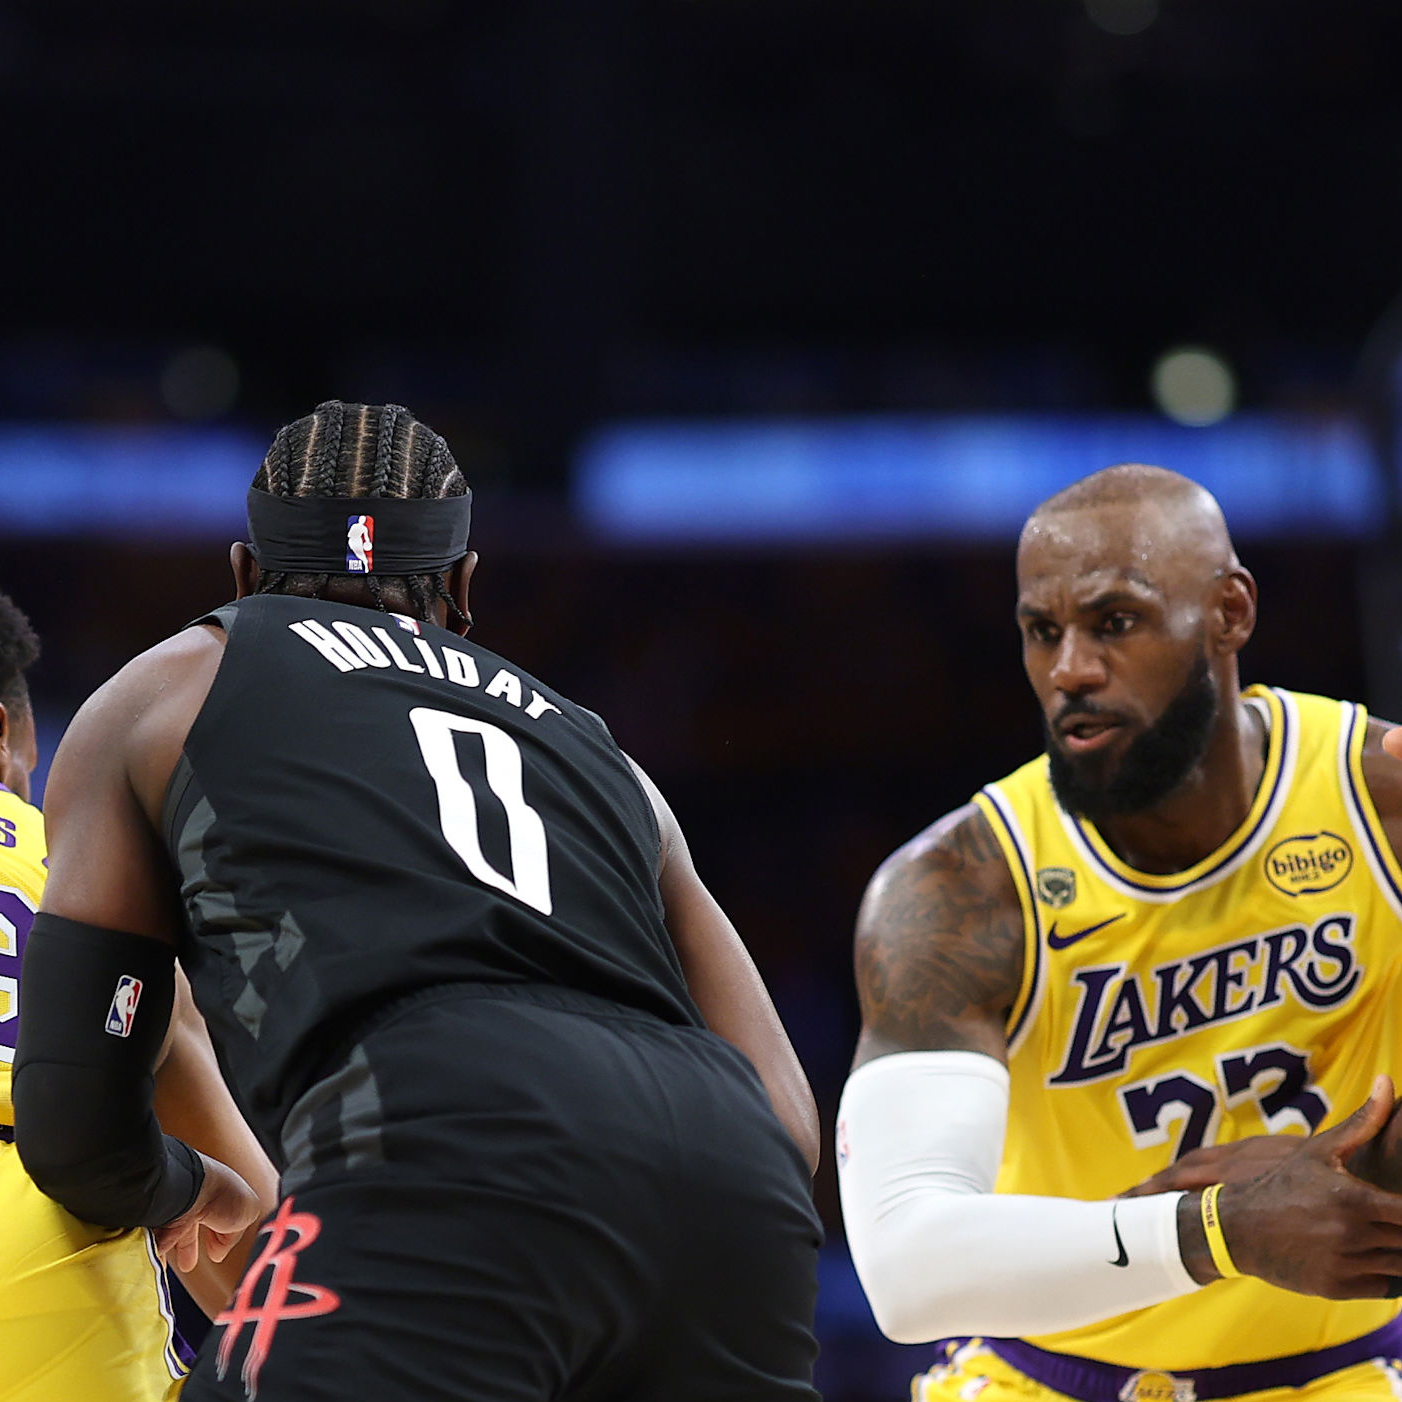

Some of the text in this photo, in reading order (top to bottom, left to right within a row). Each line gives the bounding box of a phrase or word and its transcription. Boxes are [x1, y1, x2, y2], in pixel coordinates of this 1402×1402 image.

[287, 618, 563, 721] HOLIDAY
[408, 706, 553, 917] 0
[1271, 848, 1347, 876] bibigo
[1044, 913, 1366, 1089] LAKERS
[1116, 1042, 1334, 1166] 23
